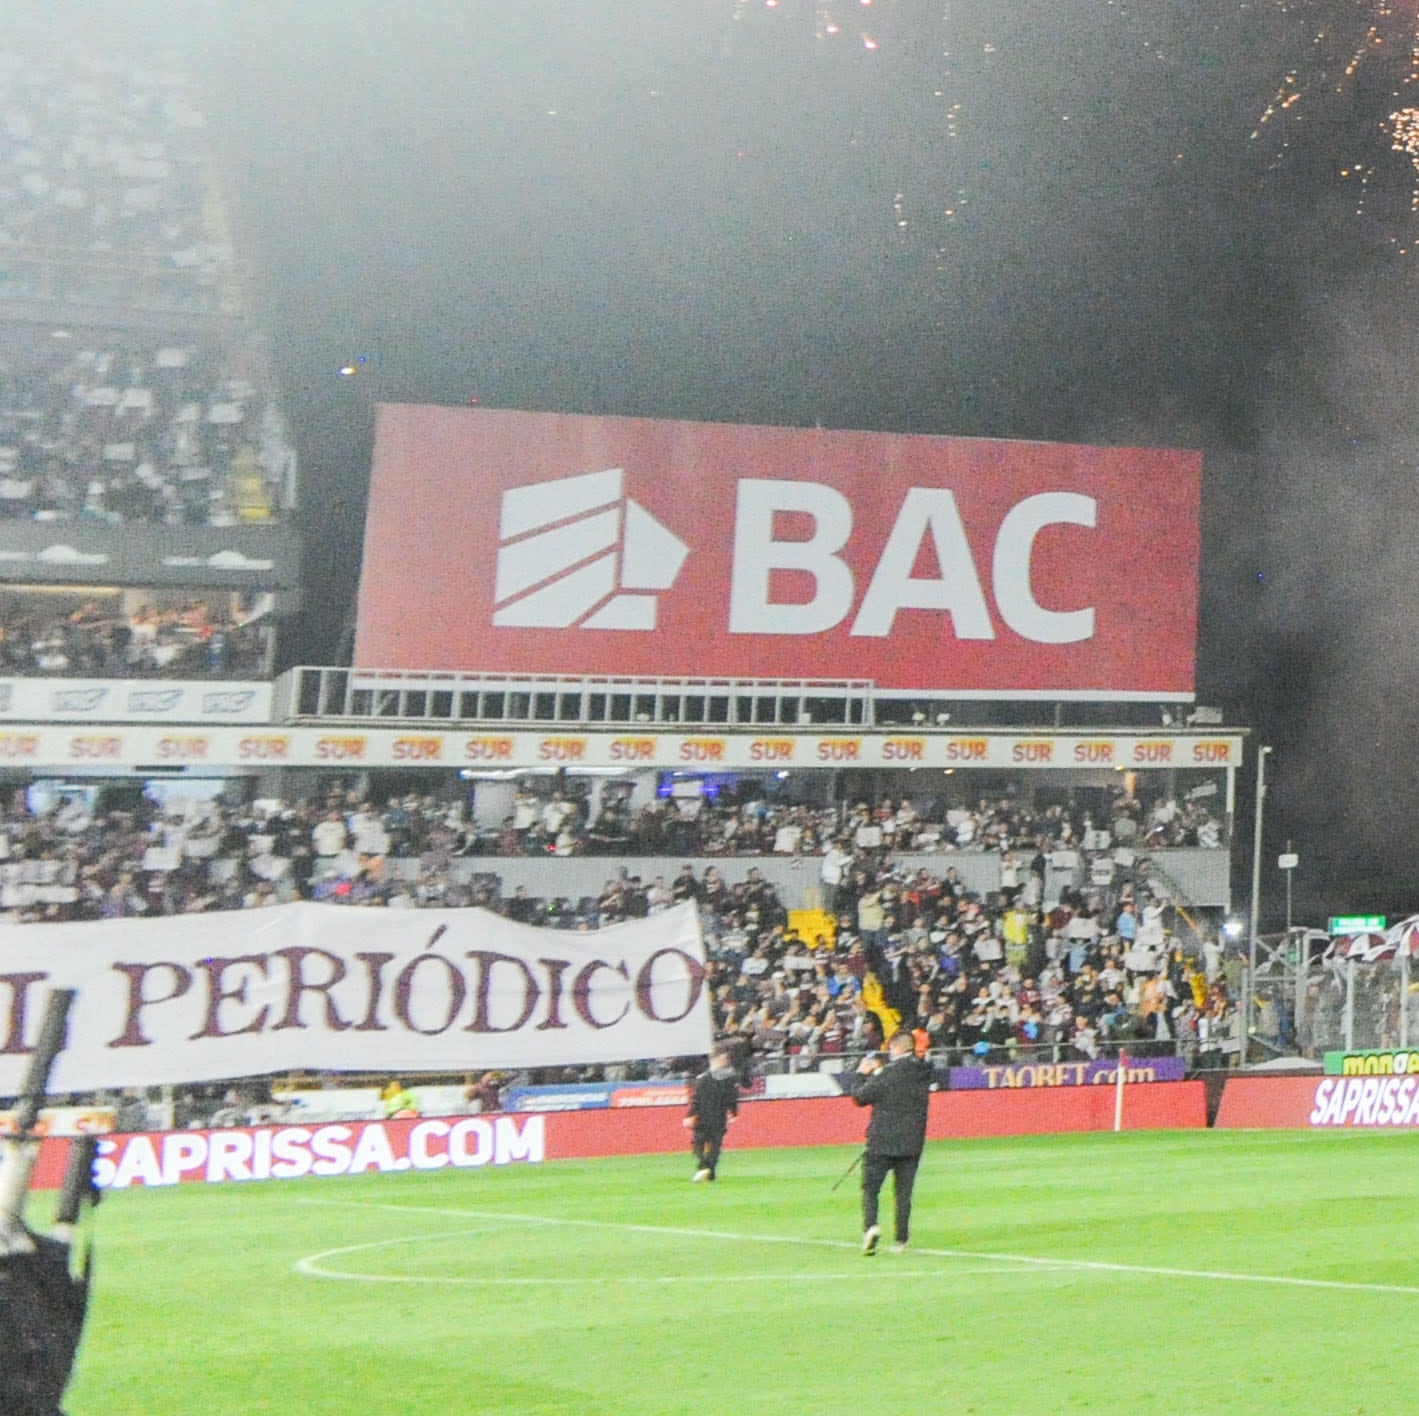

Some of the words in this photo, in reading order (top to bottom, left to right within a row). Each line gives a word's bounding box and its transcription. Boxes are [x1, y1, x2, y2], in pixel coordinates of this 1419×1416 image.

[729, 476, 1097, 644] BAC
[71, 738, 122, 759] SUR
[156, 737, 208, 759] SUR
[238, 737, 289, 759] SUR
[316, 738, 364, 760] SUR
[393, 738, 441, 760] SUR
[466, 740, 511, 760] SUR
[539, 740, 583, 760] SUR
[610, 740, 654, 761] SUR
[680, 741, 723, 761] SUR
[750, 741, 793, 761] SUR
[818, 742, 858, 761] SUR
[882, 742, 922, 761] SUR
[946, 741, 987, 761] SUR
[1012, 744, 1050, 762] SUR
[1074, 744, 1112, 763] SUR
[1134, 744, 1171, 762] SUR
[1194, 744, 1229, 762] SUR
[110, 924, 705, 1048] PERIÓDICO
[92, 1115, 545, 1189] SAPRISSA.COM
